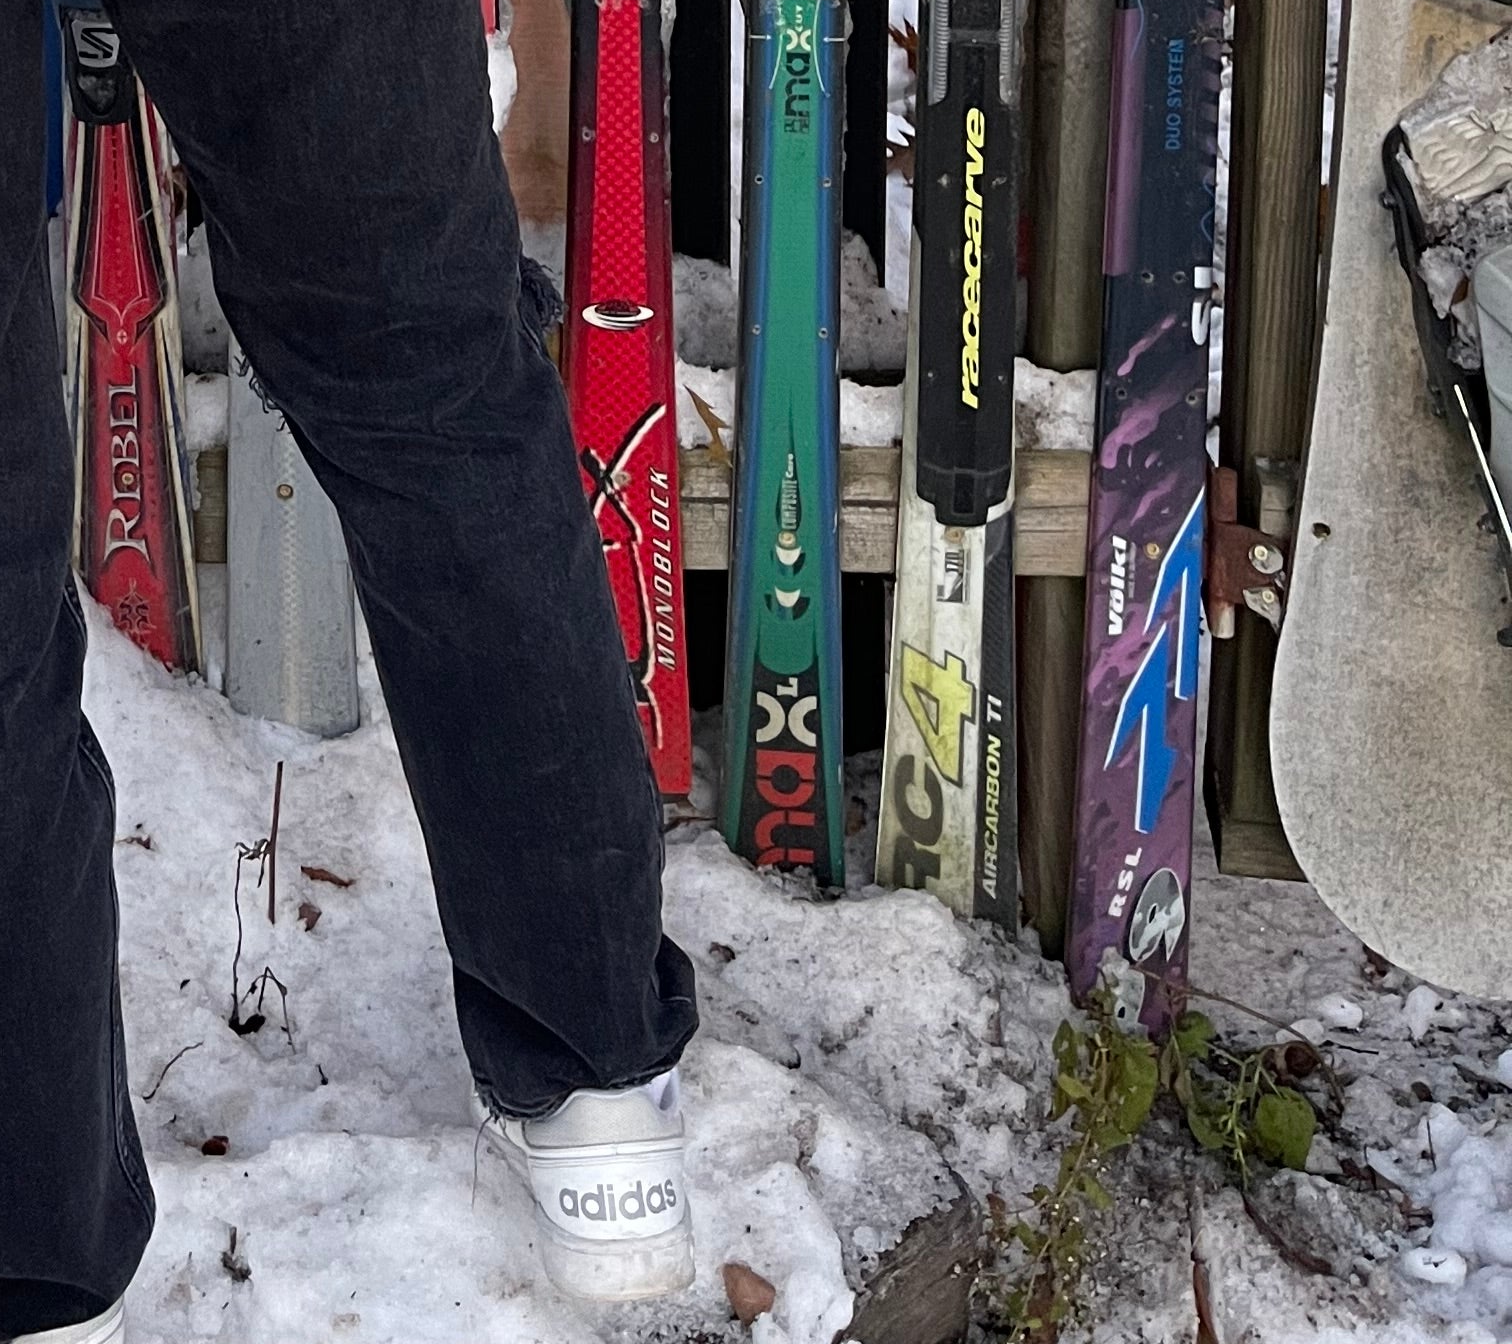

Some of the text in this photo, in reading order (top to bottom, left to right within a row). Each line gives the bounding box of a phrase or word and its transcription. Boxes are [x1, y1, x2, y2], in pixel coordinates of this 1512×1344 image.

[1164, 38, 1185, 150] DUO SYSTEM
[961, 106, 988, 410] racecarve
[104, 365, 150, 566] REBEL
[649, 467, 676, 672] MONOBLOCK
[981, 694, 1002, 901] AIRCARBON TI
[1110, 846, 1143, 918] RSL
[557, 1177, 679, 1224] adidas
